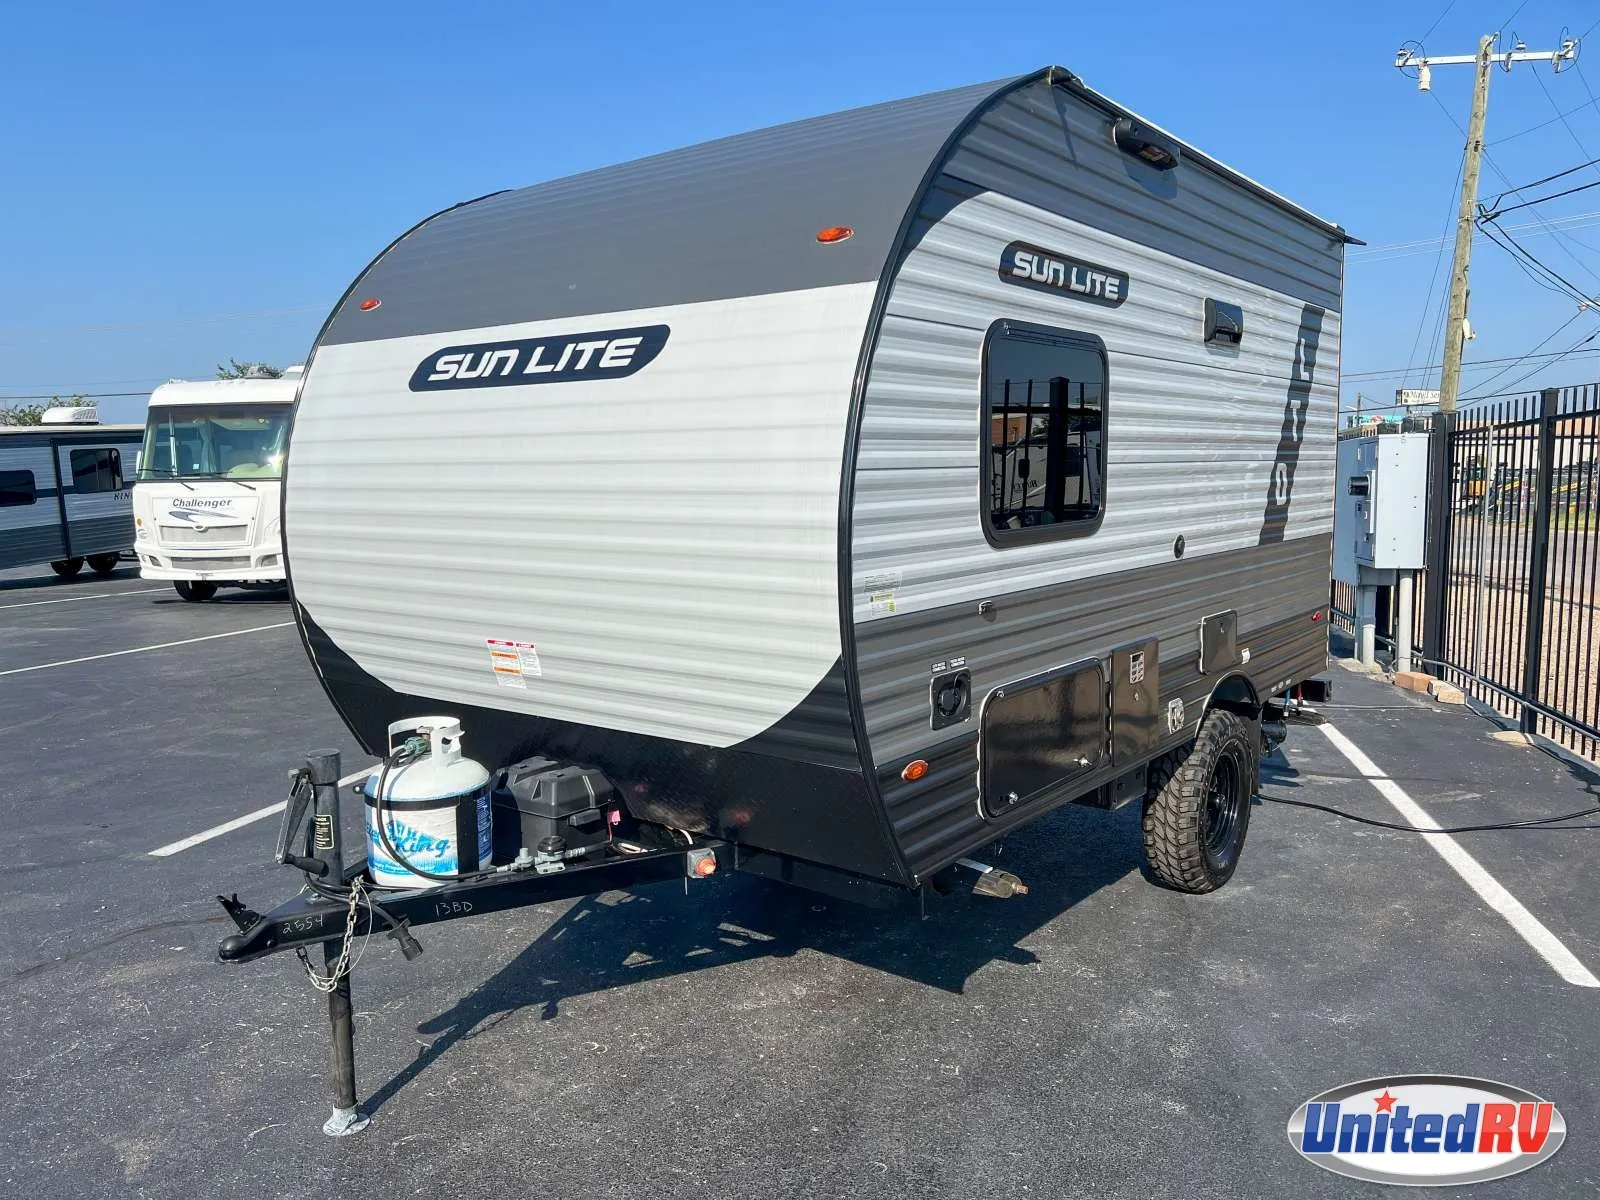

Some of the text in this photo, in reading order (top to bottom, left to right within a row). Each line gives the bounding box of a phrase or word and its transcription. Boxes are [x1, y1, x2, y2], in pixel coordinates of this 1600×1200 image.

[1012, 251, 1120, 300] SUN LITE
[428, 336, 643, 381] SUN LITE
[172, 498, 232, 508] Challenger
